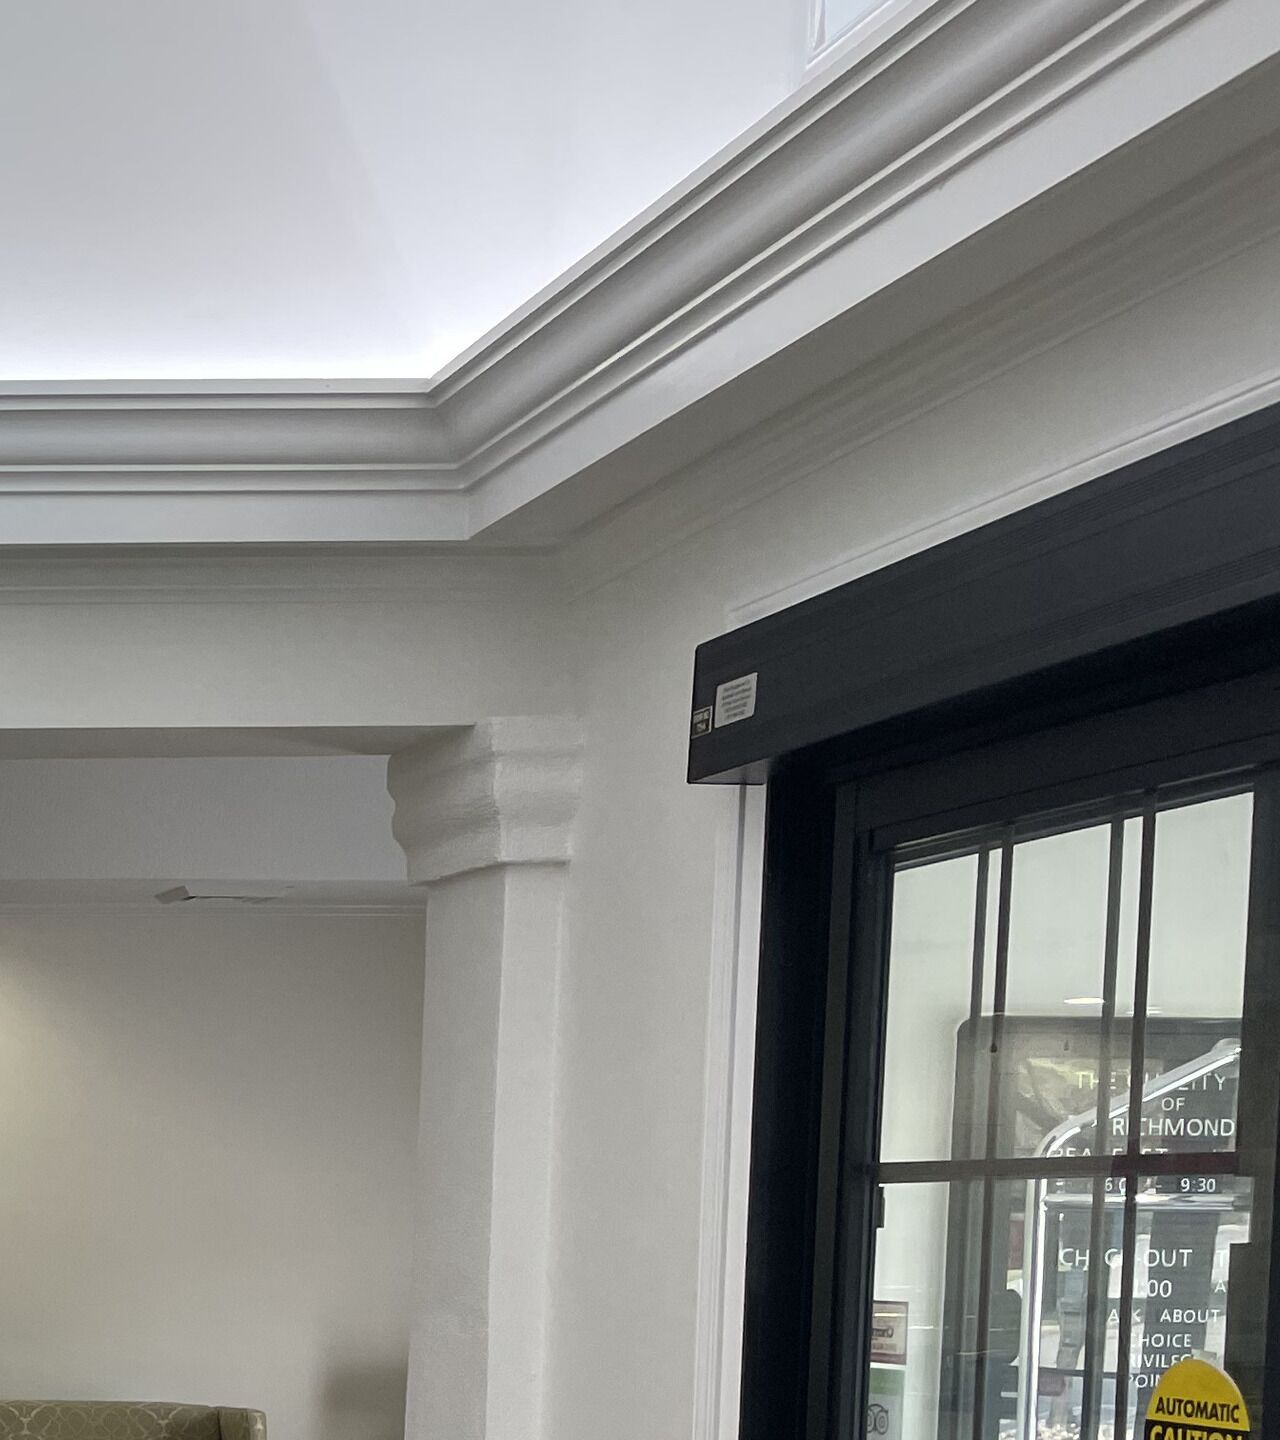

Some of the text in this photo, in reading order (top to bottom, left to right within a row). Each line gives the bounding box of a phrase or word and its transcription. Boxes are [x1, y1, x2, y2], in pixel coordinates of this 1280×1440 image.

[1161, 1097, 1185, 1112] OF
[1180, 1177, 1216, 1193] 9:30
[1059, 1248, 1192, 1268] CHC-OUT
[1107, 1309, 1221, 1323] AK ABOUT
[1129, 1373, 1162, 1388] OIN
[1155, 1396, 1240, 1424] AUTOMATIC
